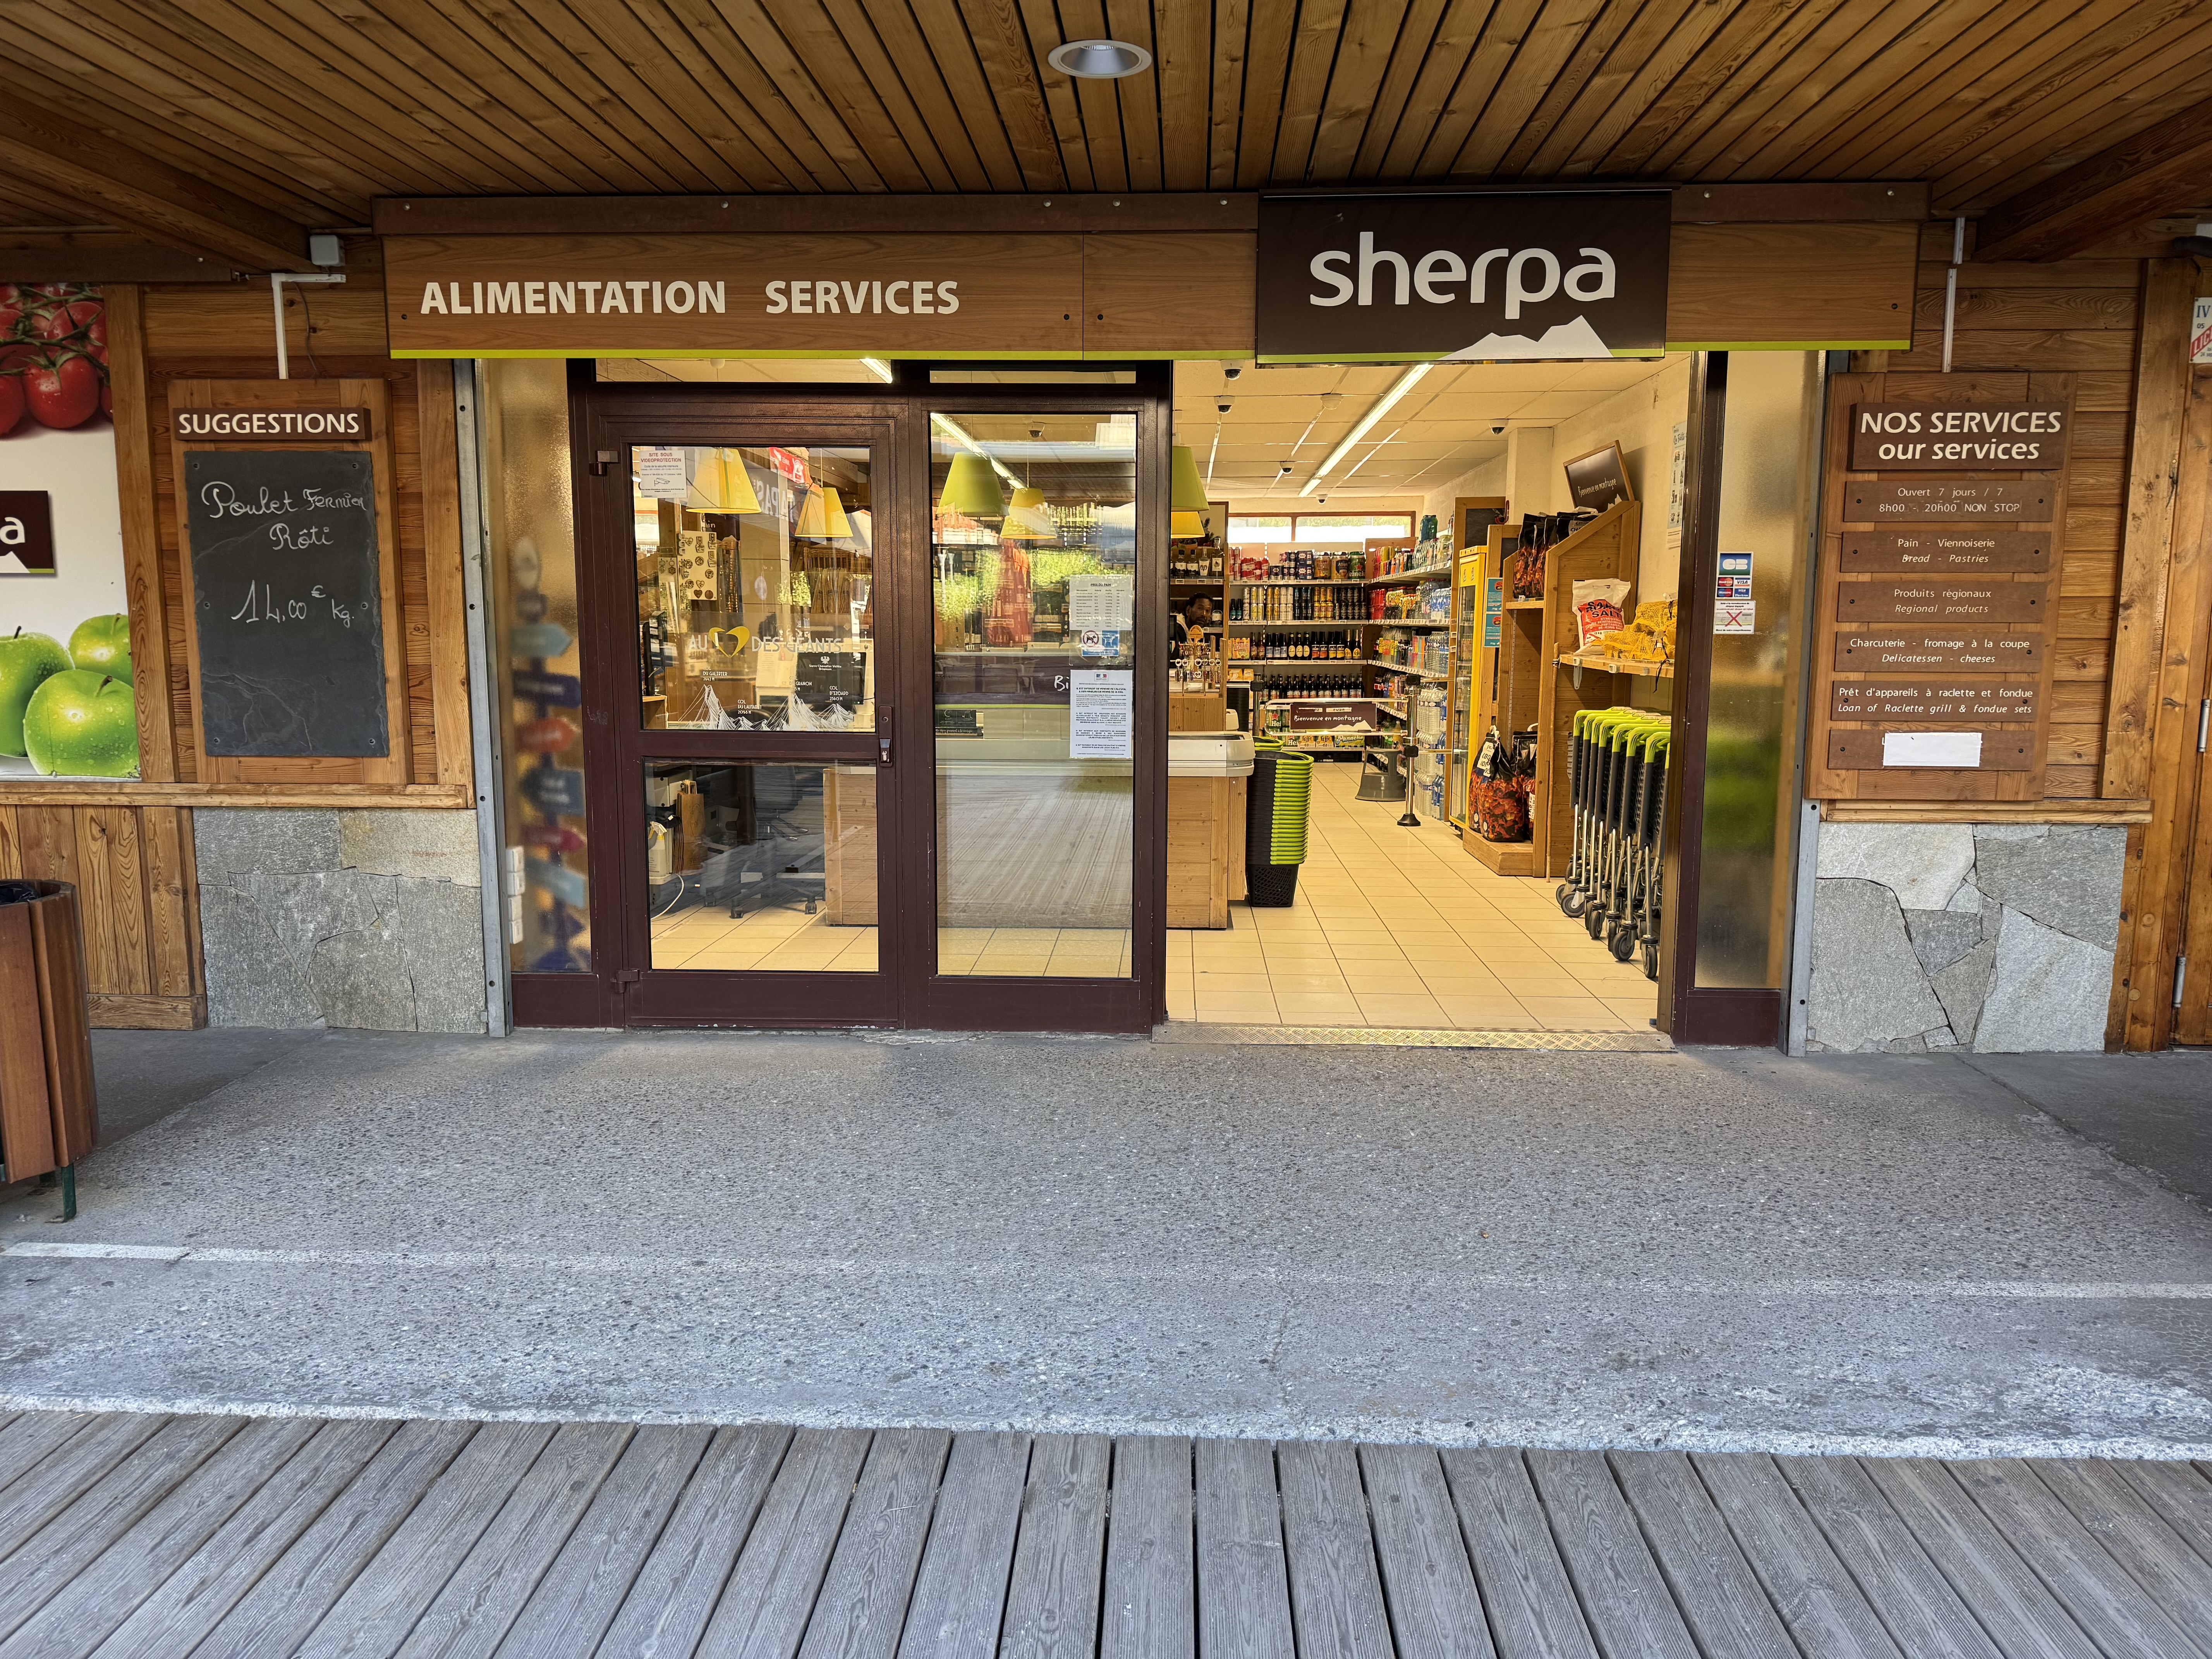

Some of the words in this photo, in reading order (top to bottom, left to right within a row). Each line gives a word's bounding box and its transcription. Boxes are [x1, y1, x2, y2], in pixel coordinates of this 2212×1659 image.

[1310, 231, 1616, 321] sherpa
[421, 281, 725, 314] ALIMENTATION
[766, 280, 959, 314] SERVICES
[179, 413, 359, 434] SUGGESTIONS
[1861, 412, 1922, 433] NOS
[1929, 412, 2061, 433] SERVICES
[1879, 443, 1926, 460] our
[1932, 438, 2040, 460] services
[1898, 488, 1930, 496] Ouvert
[1939, 488, 1944, 496] 7
[1951, 488, 1976, 498] jours
[1984, 488, 1989, 496] /
[201, 481, 298, 518] Poulet
[1879, 503, 1905, 512] 8h00
[1924, 503, 1956, 512] 20h00
[1965, 503, 1986, 512] NON
[1994, 503, 2020, 512] STOP
[270, 523, 334, 550] Rôti
[1898, 539, 1918, 547] Pain
[1938, 539, 1995, 547] Viennoiserie
[1902, 554, 1930, 562] Bread
[1949, 554, 1989, 563] Pastries
[1894, 589, 1934, 597] Produits
[1942, 589, 1991, 600] régionaux
[1895, 604, 1938, 614] Regional
[1945, 604, 1988, 615] products
[689, 634, 708, 650] AU
[752, 636, 780, 652] DES
[1850, 638, 1905, 647] Charcuterie
[1925, 639, 1964, 649] fromage
[1971, 639, 1977, 647] à
[1985, 639, 1993, 647] la
[2000, 641, 2030, 649] coupe
[1882, 654, 1942, 662] Delicatessen
[1960, 654, 1996, 663] cheeses
[1839, 688, 1859, 696] Prêt
[1866, 688, 1918, 698] d'appareils
[1926, 688, 1931, 697] à
[1939, 688, 1975, 697] raclette
[1999, 688, 2033, 697] fondue
[1838, 704, 1861, 712] Loan
[1867, 703, 1878, 712] of
[1884, 704, 1924, 712] Raclette
[1930, 704, 1952, 714] grill
[1959, 704, 1966, 713] &
[1974, 704, 2008, 713] fondue
